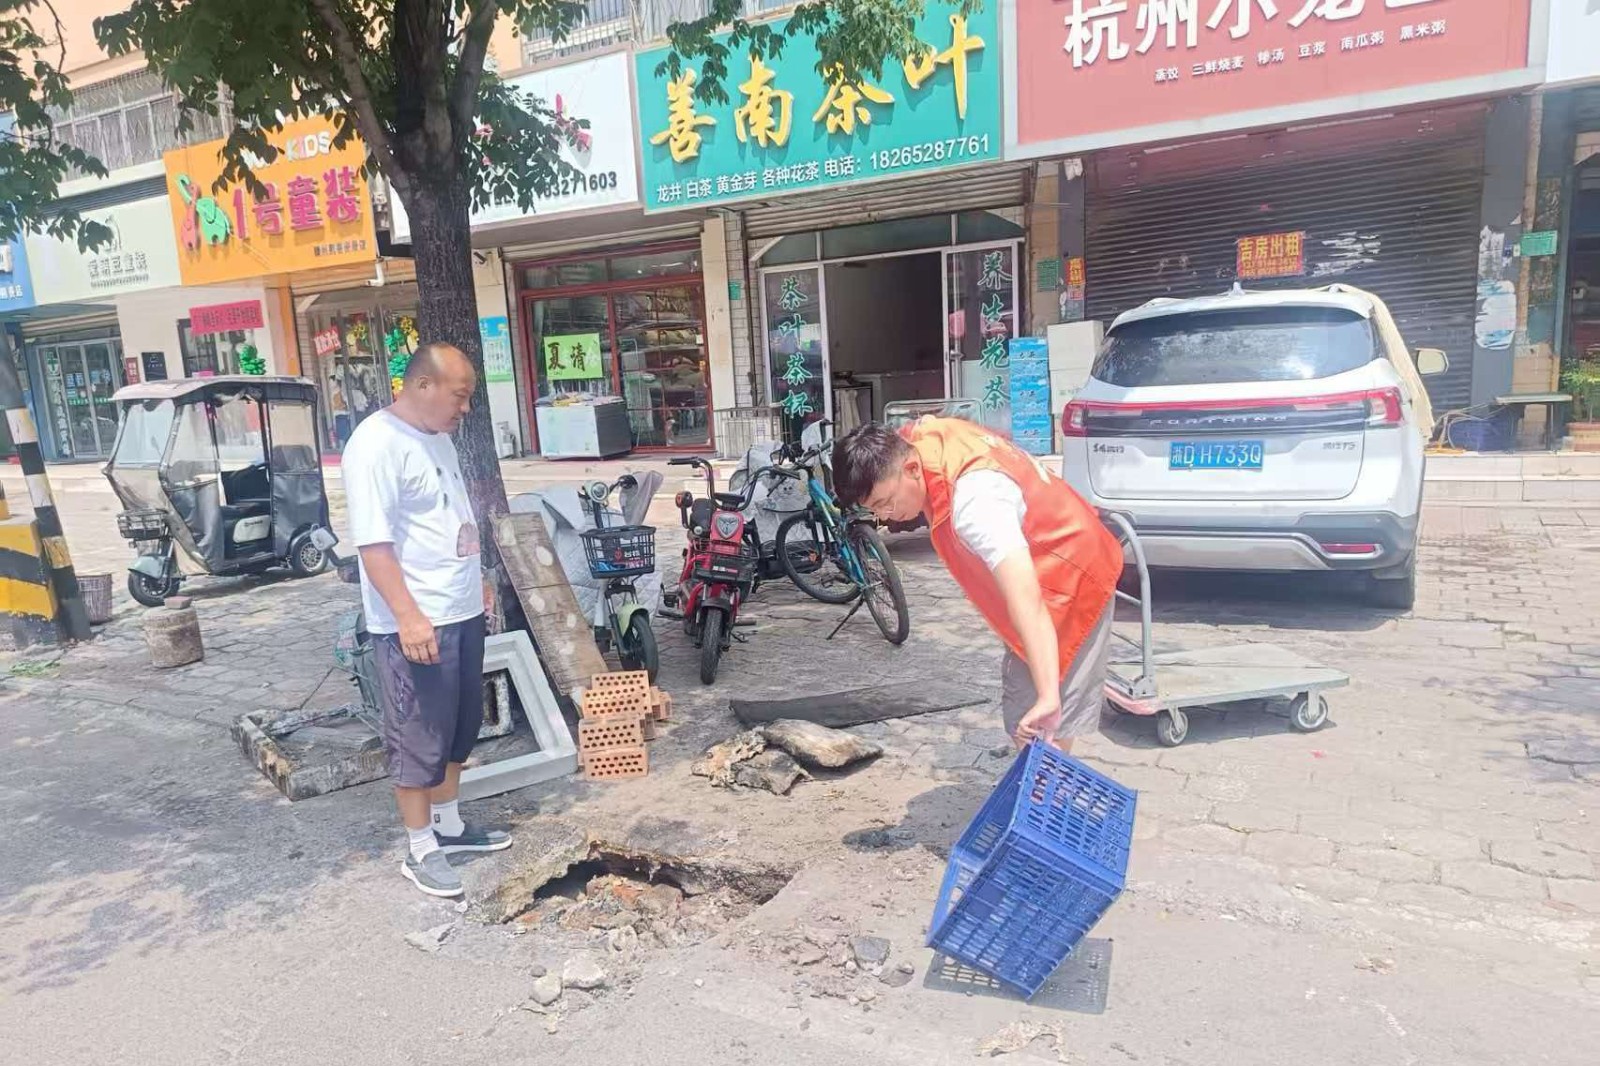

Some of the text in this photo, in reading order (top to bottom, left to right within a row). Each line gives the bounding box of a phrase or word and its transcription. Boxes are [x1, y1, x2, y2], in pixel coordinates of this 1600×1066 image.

[1064, 0, 1435, 67] 杭州小
[1298, 41, 1326, 57] 豆浆
[1340, 31, 1384, 50] 南瓜粥
[1400, 19, 1446, 40] 黑米粥
[286, 131, 331, 162] KIDS
[657, 182, 682, 203] 龙井
[686, 178, 712, 198] 白茶
[716, 171, 757, 194] 黄金芽
[762, 160, 819, 188] 各种花茶
[870, 133, 989, 170] 18265287761
[233, 166, 361, 240] 1号童装
[1240, 232, 1299, 261] 吉房出租
[778, 276, 813, 419] 茶叶茶杯
[977, 250, 1012, 413] 养生花茶
